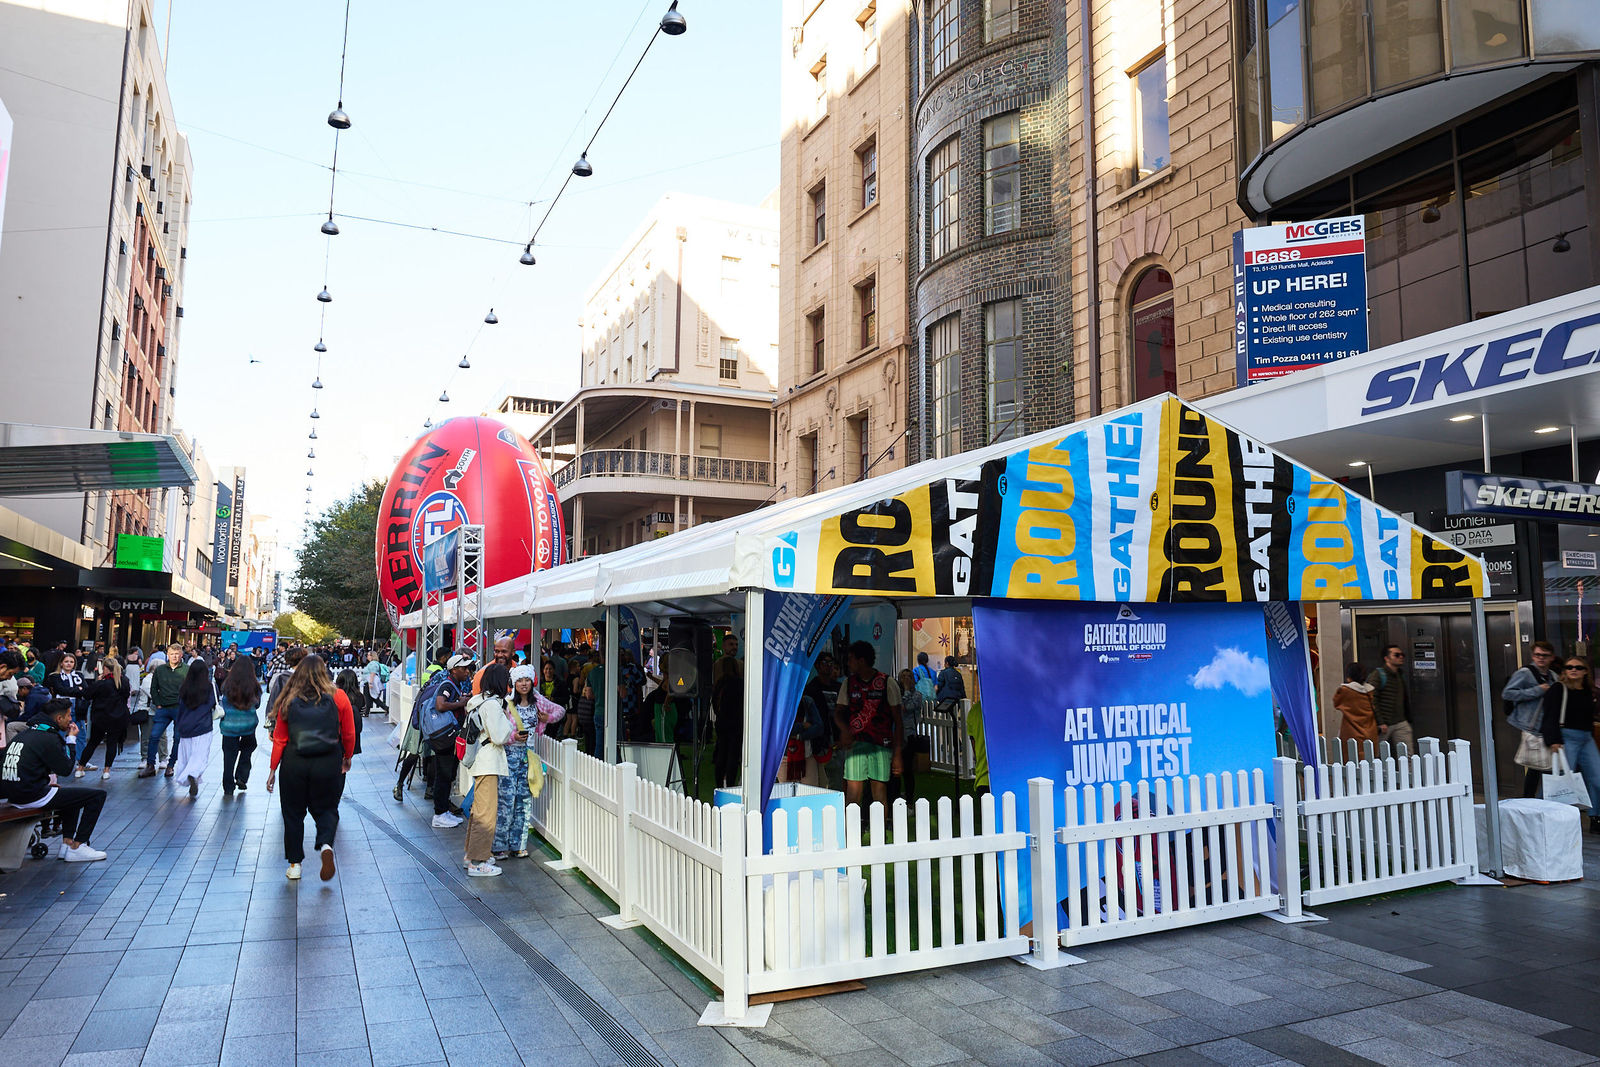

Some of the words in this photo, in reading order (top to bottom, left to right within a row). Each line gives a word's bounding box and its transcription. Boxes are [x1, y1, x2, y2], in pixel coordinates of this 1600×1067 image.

[1286, 220, 1361, 240] McGEES
[1252, 249, 1301, 263] lease
[1253, 280, 1280, 295] UP
[1286, 272, 1348, 292] HERE!
[1261, 303, 1292, 312] Medical
[1294, 299, 1336, 311] consulting
[1262, 314, 1287, 323] Whole
[1289, 312, 1307, 321] floor
[1309, 310, 1317, 319] of
[1319, 309, 1335, 318] 262
[1262, 325, 1285, 334] Direct
[1287, 323, 1297, 332] lift
[1299, 322, 1328, 330] access
[1262, 336, 1293, 345] Existing
[1296, 334, 1310, 342] use
[1312, 331, 1348, 341] dentistry
[1254, 355, 1271, 364] Tim
[1273, 354, 1299, 363] Pozza
[1301, 352, 1321, 361] 0411
[1323, 350, 1335, 359] 41
[1336, 349, 1347, 358] 81
[1350, 349, 1360, 357] 61
[457, 449, 471, 470] SOUTH
[528, 468, 549, 534] TOYOTA
[1155, 403, 1227, 604] ROUND
[233, 502, 243, 538] CENTRAL
[424, 498, 455, 546] FL
[216, 521, 228, 564] Woolworths
[1469, 530, 1492, 539] DATA
[230, 540, 241, 580] ADELAIDE
[122, 601, 158, 610] HYPE
[788, 602, 816, 656] FESTIVAL
[1085, 623, 1126, 645] GATHER
[1129, 623, 1167, 644] ROUND
[1270, 619, 1287, 650] FOOTY
[1064, 707, 1098, 742] AFL
[1101, 702, 1191, 739] VERTICAL
[6, 741, 24, 756] AIR
[3, 755, 20, 769] JOR
[1066, 741, 1132, 786] JUMP
[1137, 737, 1192, 779] TEST
